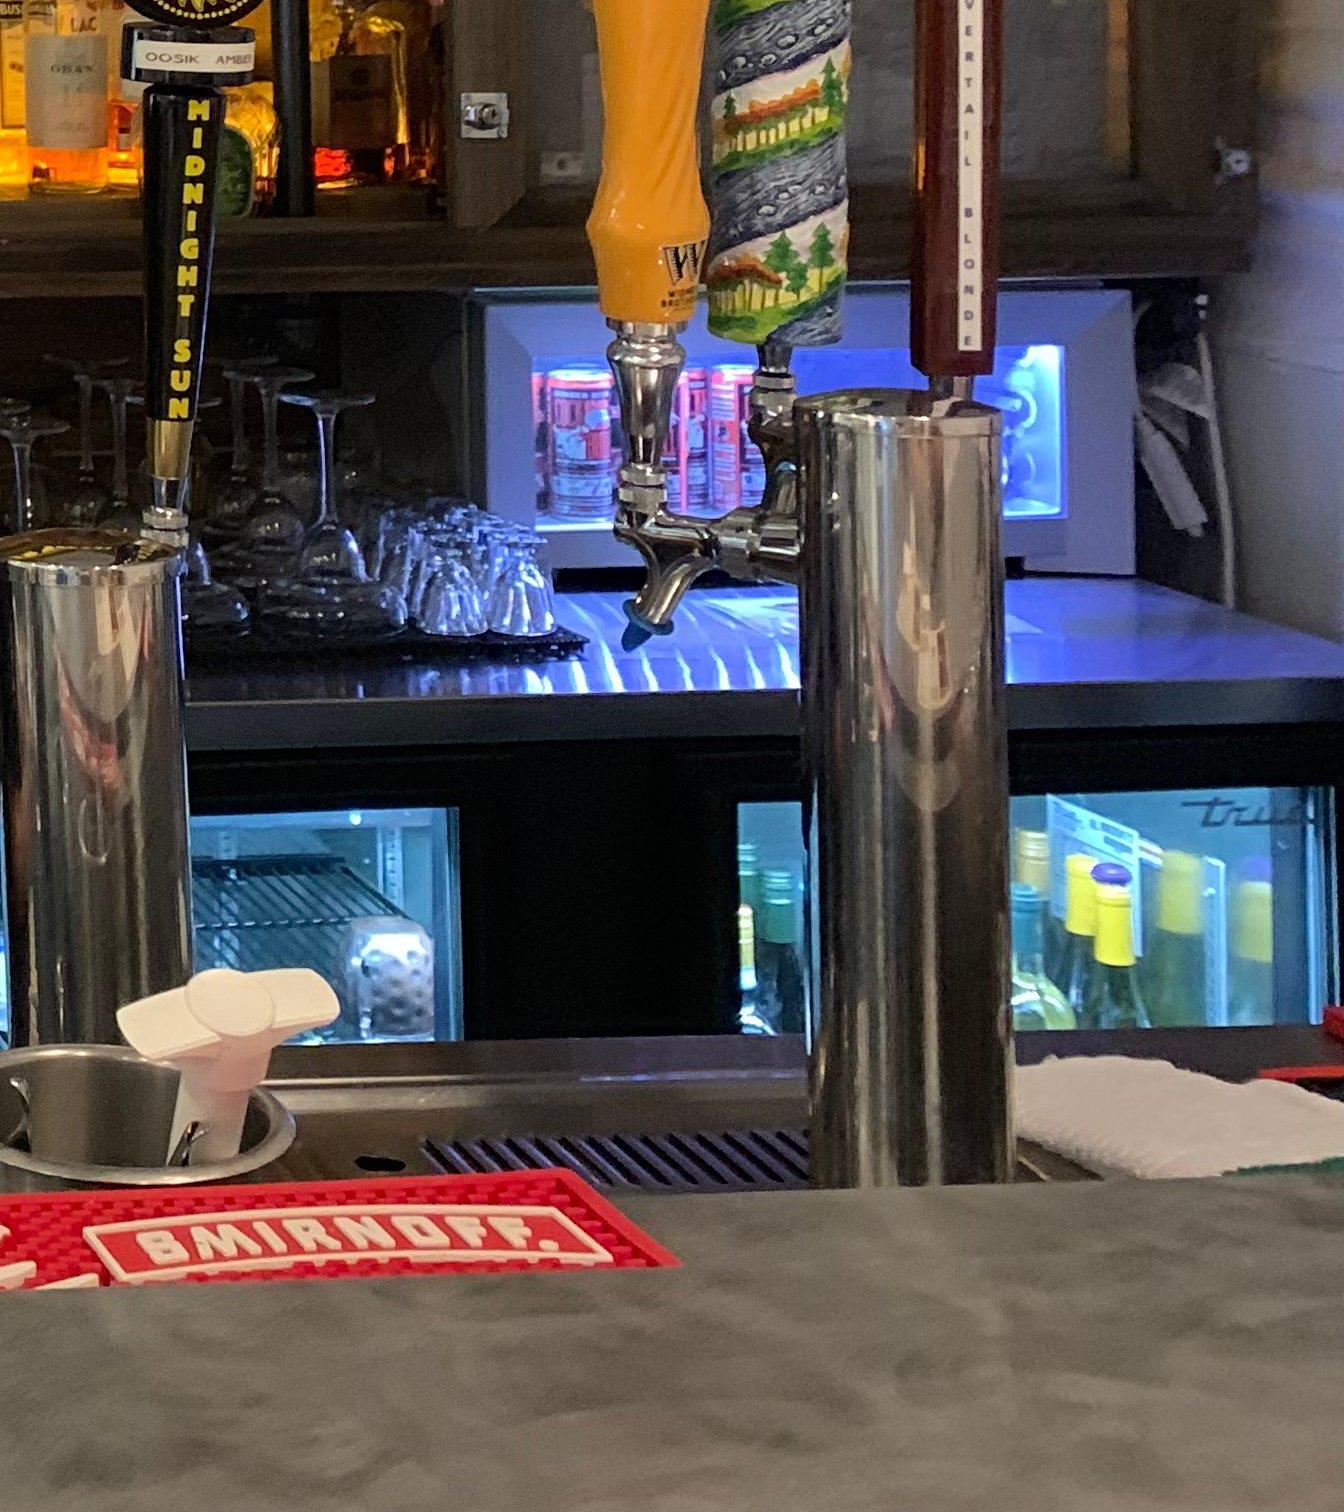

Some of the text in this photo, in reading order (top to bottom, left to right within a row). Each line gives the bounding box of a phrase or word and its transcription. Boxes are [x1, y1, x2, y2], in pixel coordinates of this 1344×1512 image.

[145, 52, 200, 65] OOSIK
[168, 99, 210, 420] MIDNIGHT SUN
[962, 205, 976, 348] BLONDE
